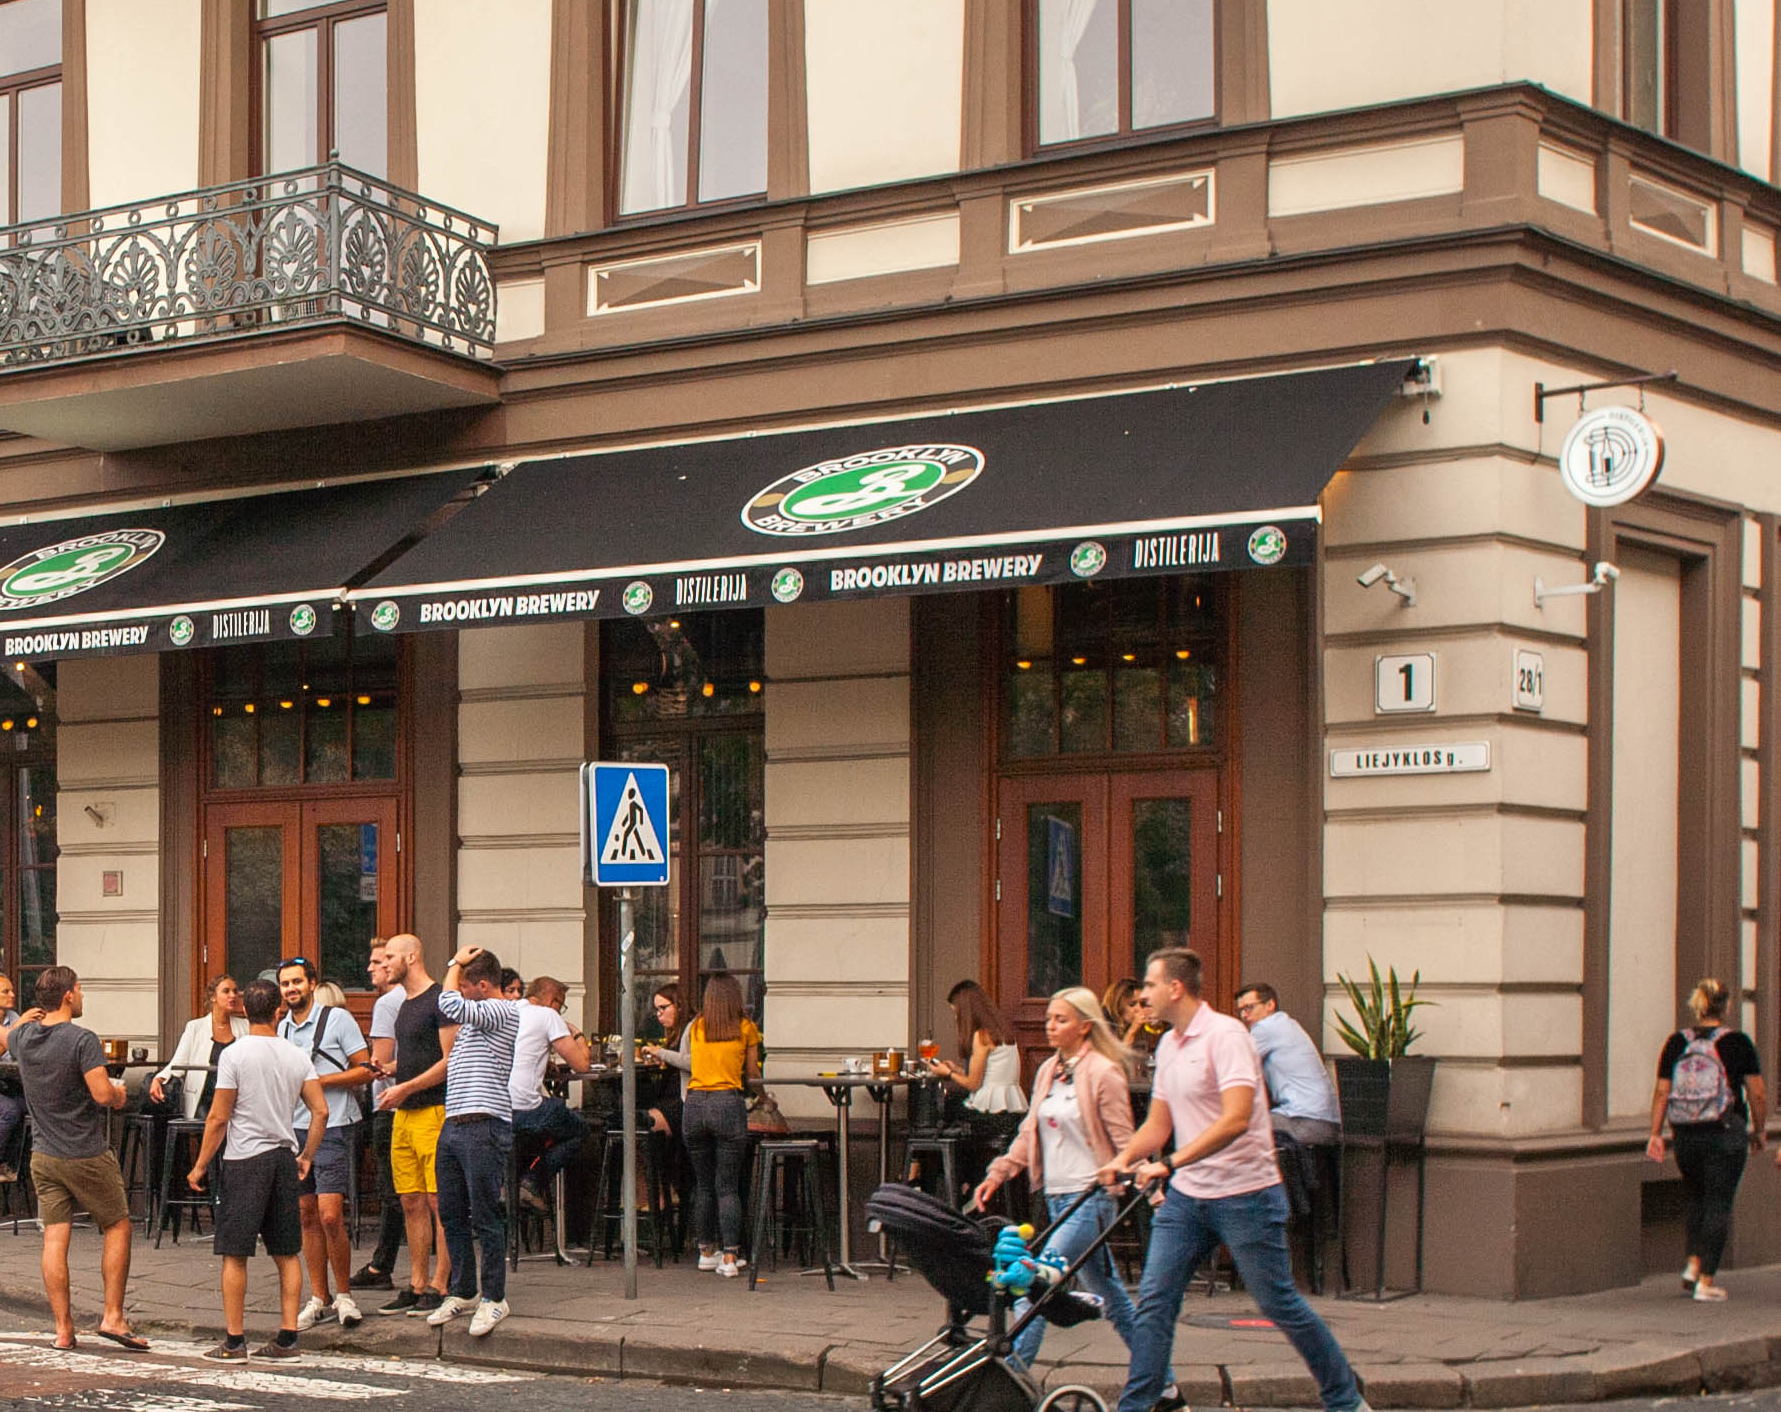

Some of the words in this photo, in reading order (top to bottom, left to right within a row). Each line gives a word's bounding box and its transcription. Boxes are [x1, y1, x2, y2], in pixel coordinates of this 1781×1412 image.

[794, 446, 971, 483] BROOKLYN
[753, 497, 926, 533] BREWERY
[1135, 532, 1220, 568] DISTILERIJA
[830, 562, 940, 591] BROOKLYN
[942, 554, 1043, 583] BREWERY
[420, 596, 514, 623] BROOKLYN
[515, 589, 600, 616] BREWERY
[676, 574, 748, 606] DISTILERIJA
[5, 631, 80, 656] BROOKLYN
[81, 626, 149, 650] BREWERY
[213, 610, 270, 638] DISTILERIJA
[1398, 663, 1413, 701] 1
[1519, 663, 1542, 697] 28/1
[1356, 750, 1443, 769] LIEJYKLOS
